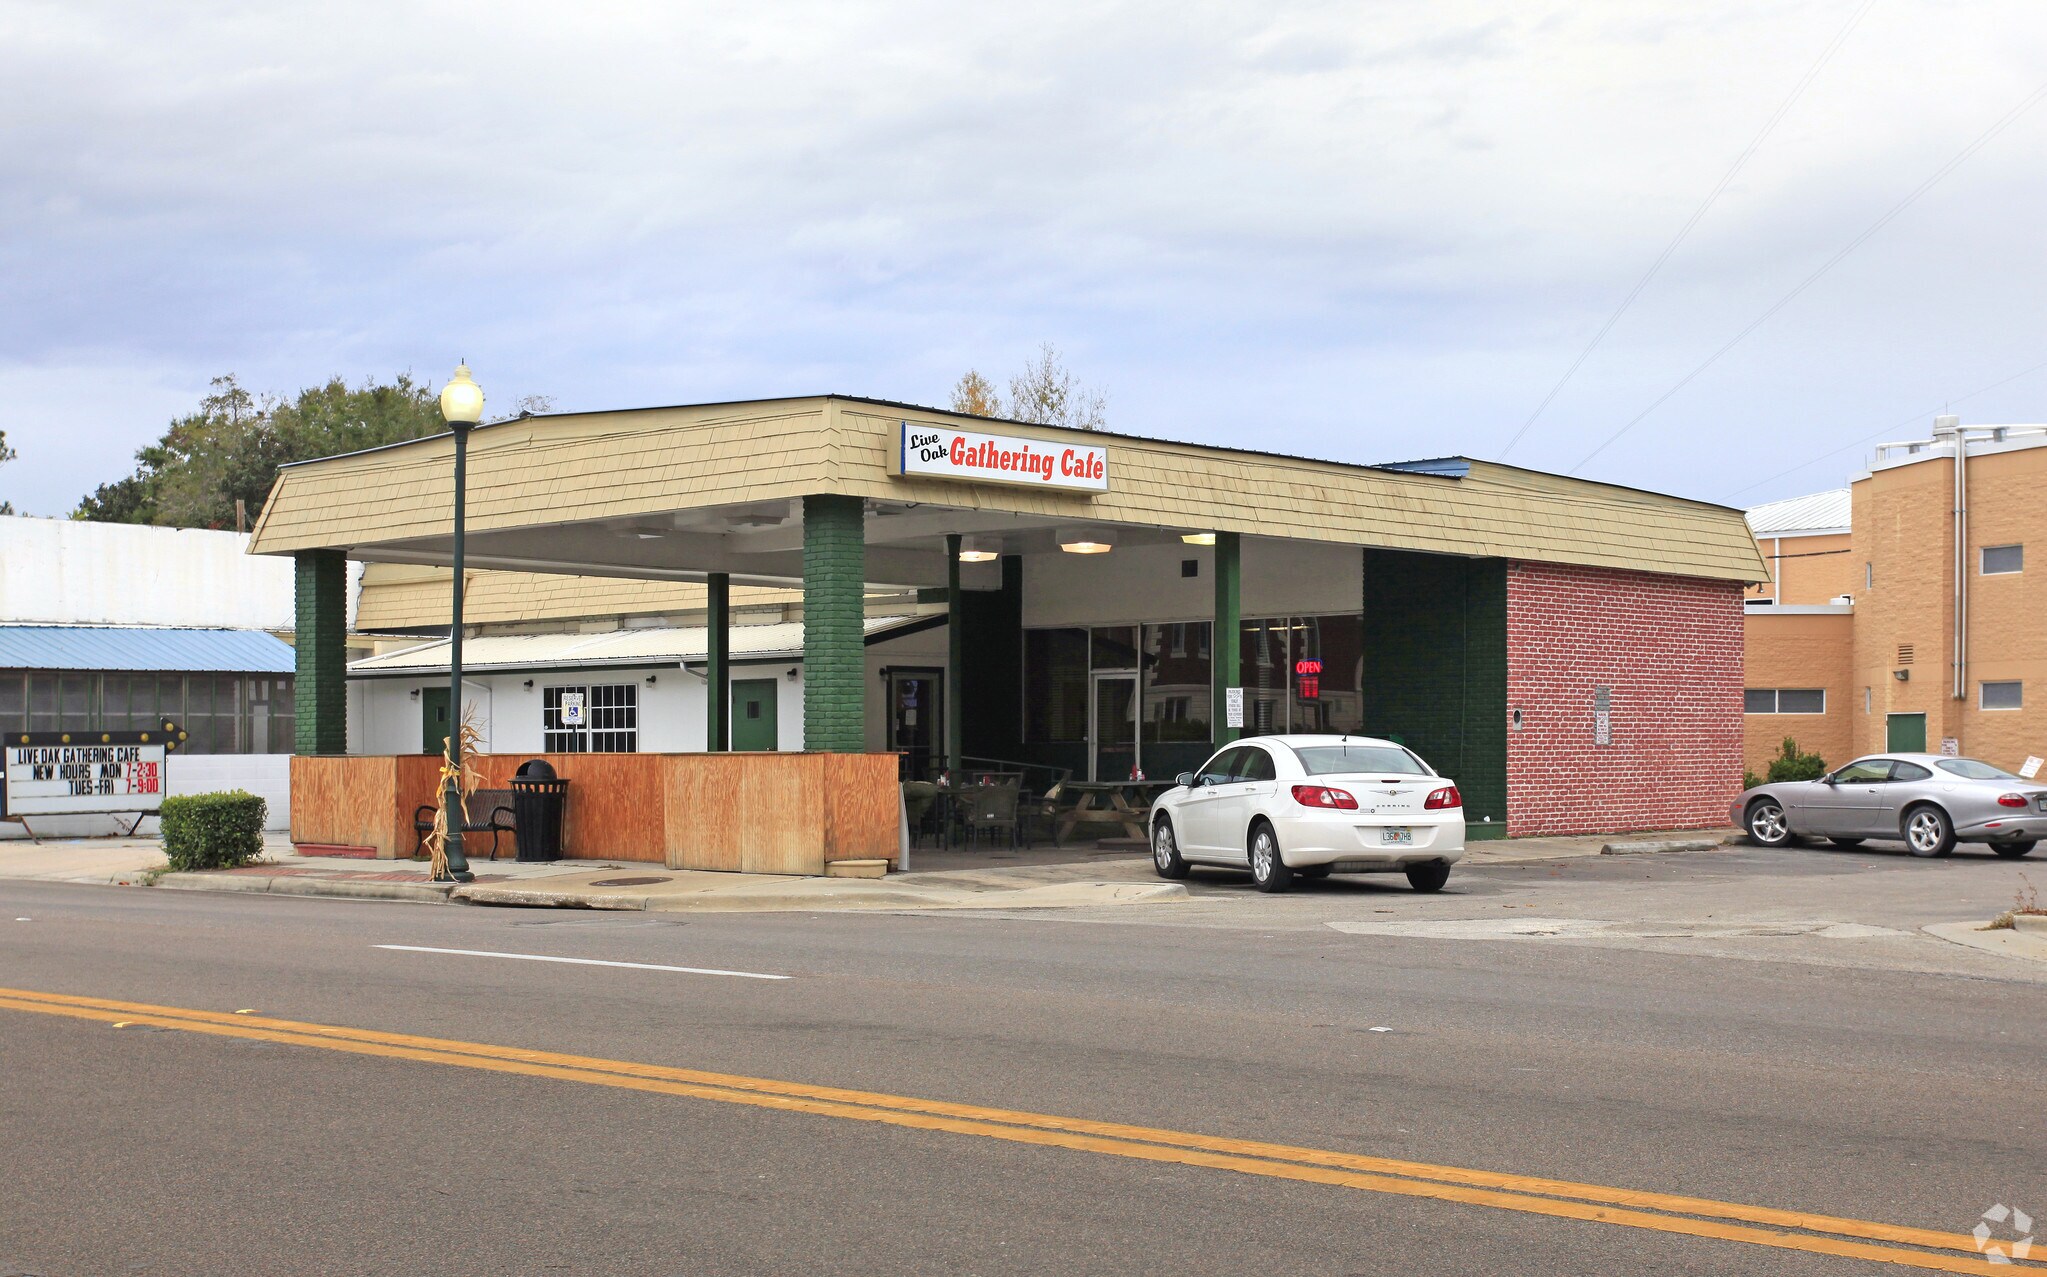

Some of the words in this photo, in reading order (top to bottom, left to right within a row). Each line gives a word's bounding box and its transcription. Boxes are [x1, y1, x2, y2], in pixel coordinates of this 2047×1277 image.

[910, 433, 940, 449] Live
[921, 444, 949, 463] Oak
[949, 436, 1055, 481] Gathering
[1060, 448, 1104, 480] Café
[1296, 661, 1321, 674] OPEN
[18, 749, 39, 764] LIVE
[41, 748, 60, 764] OAK
[63, 748, 114, 763] GATHERING
[117, 747, 140, 762] CAFE
[33, 764, 54, 780] NEW
[60, 764, 91, 779] HOURS
[100, 763, 122, 779] MON
[126, 762, 158, 778] 7-2:30
[126, 778, 159, 794] 7-9:00
